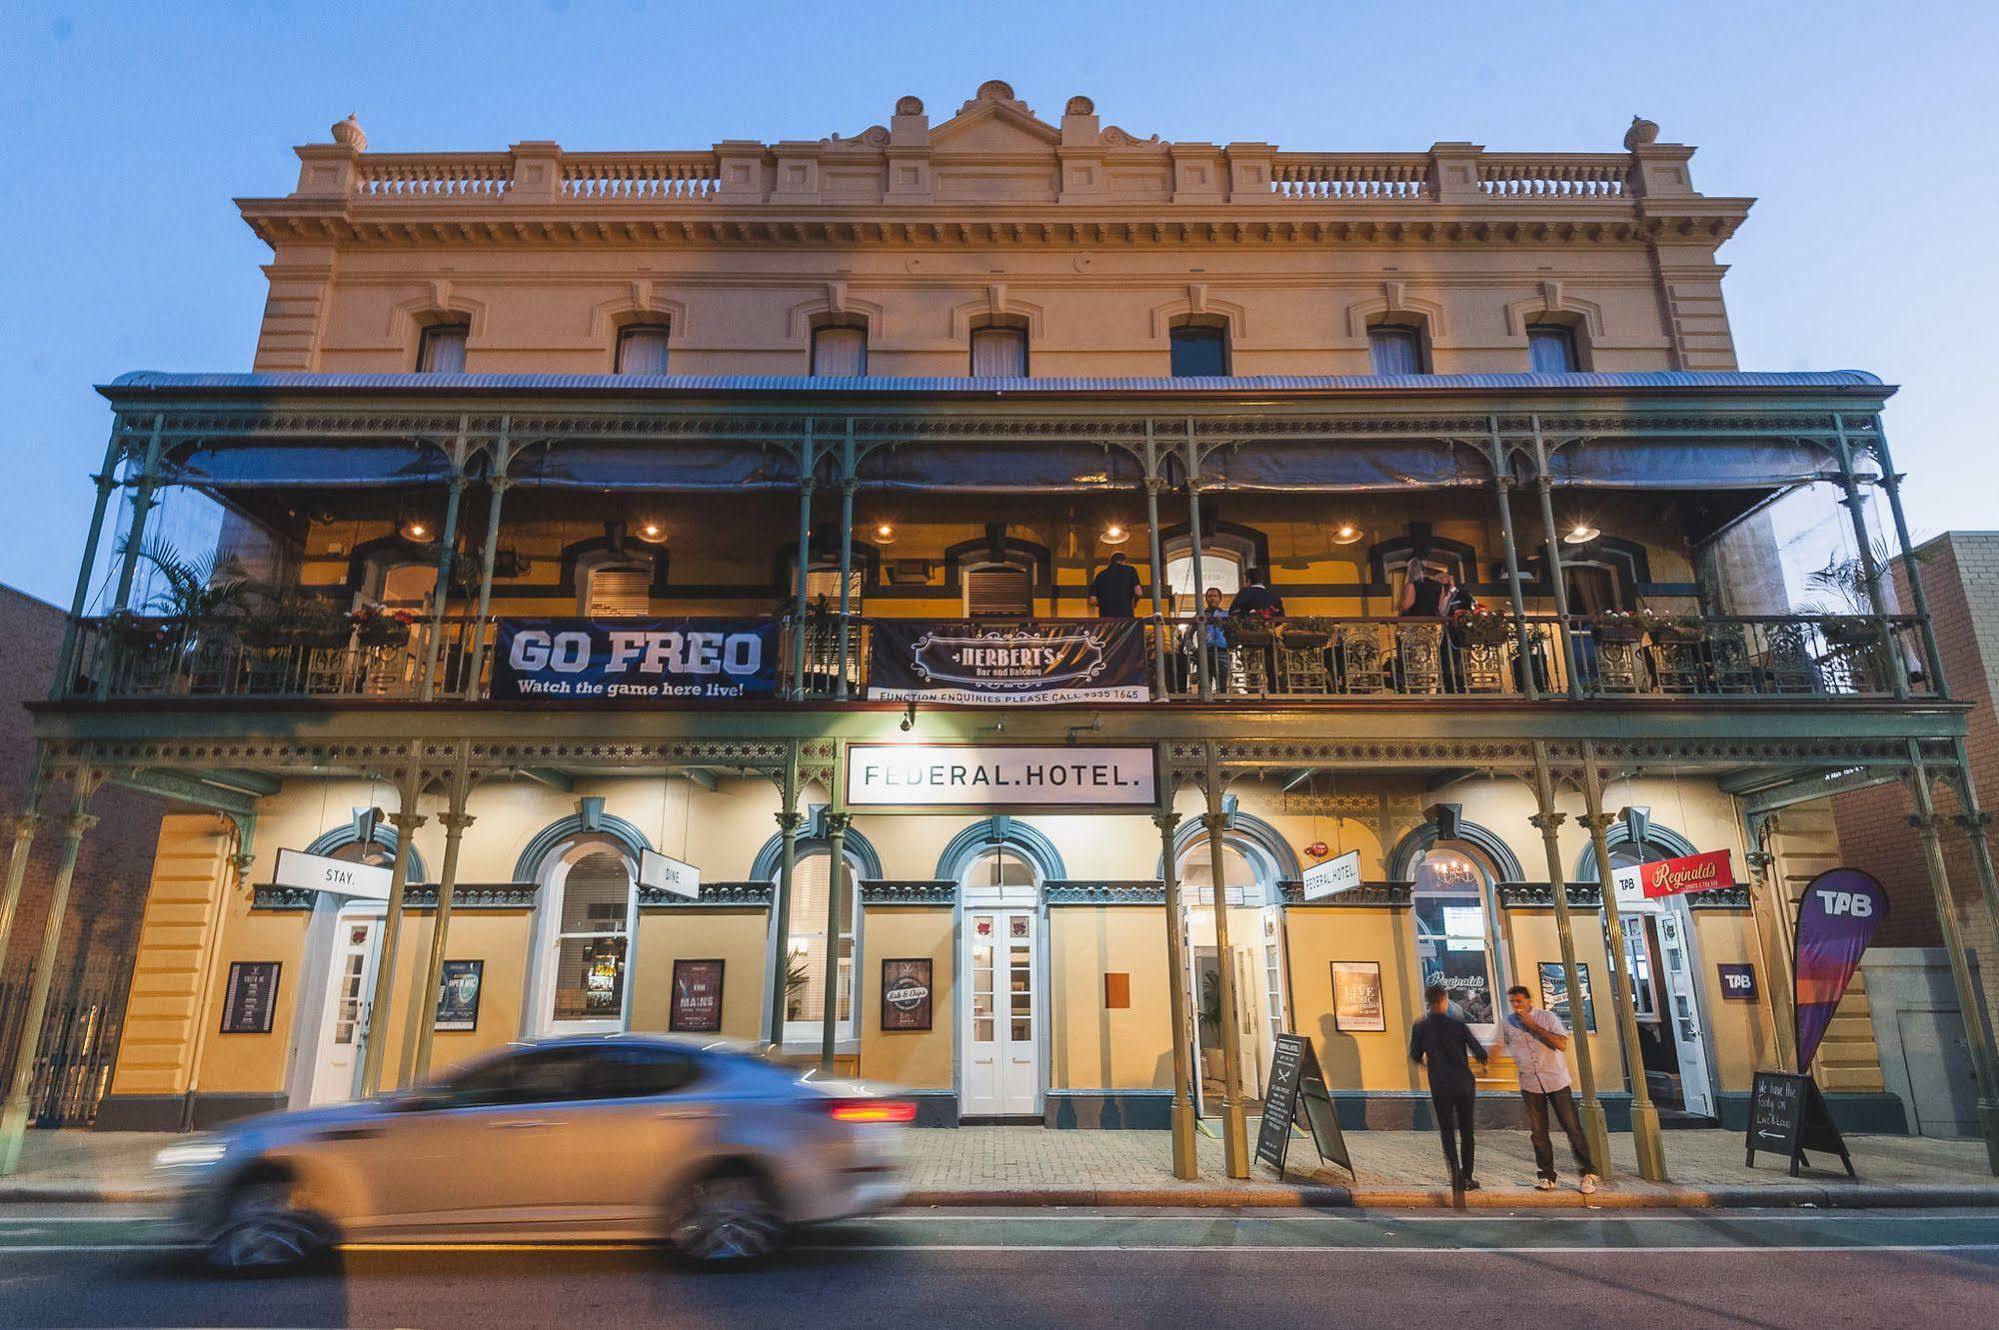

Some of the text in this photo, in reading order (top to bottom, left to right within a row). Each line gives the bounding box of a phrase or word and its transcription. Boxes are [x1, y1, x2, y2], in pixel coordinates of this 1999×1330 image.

[509, 630, 762, 675] GO FREO
[962, 646, 1055, 666] HERBERT'S
[517, 679, 744, 698] Watch the game here live!
[1005, 693, 1048, 703] PLEASE
[1115, 690, 1139, 699] 1645
[326, 868, 356, 886] STAY.
[1619, 878, 1635, 890] TAB
[1651, 861, 1716, 892] Reginald's
[1816, 890, 1873, 917] TAB
[1725, 974, 1751, 989] TAB
